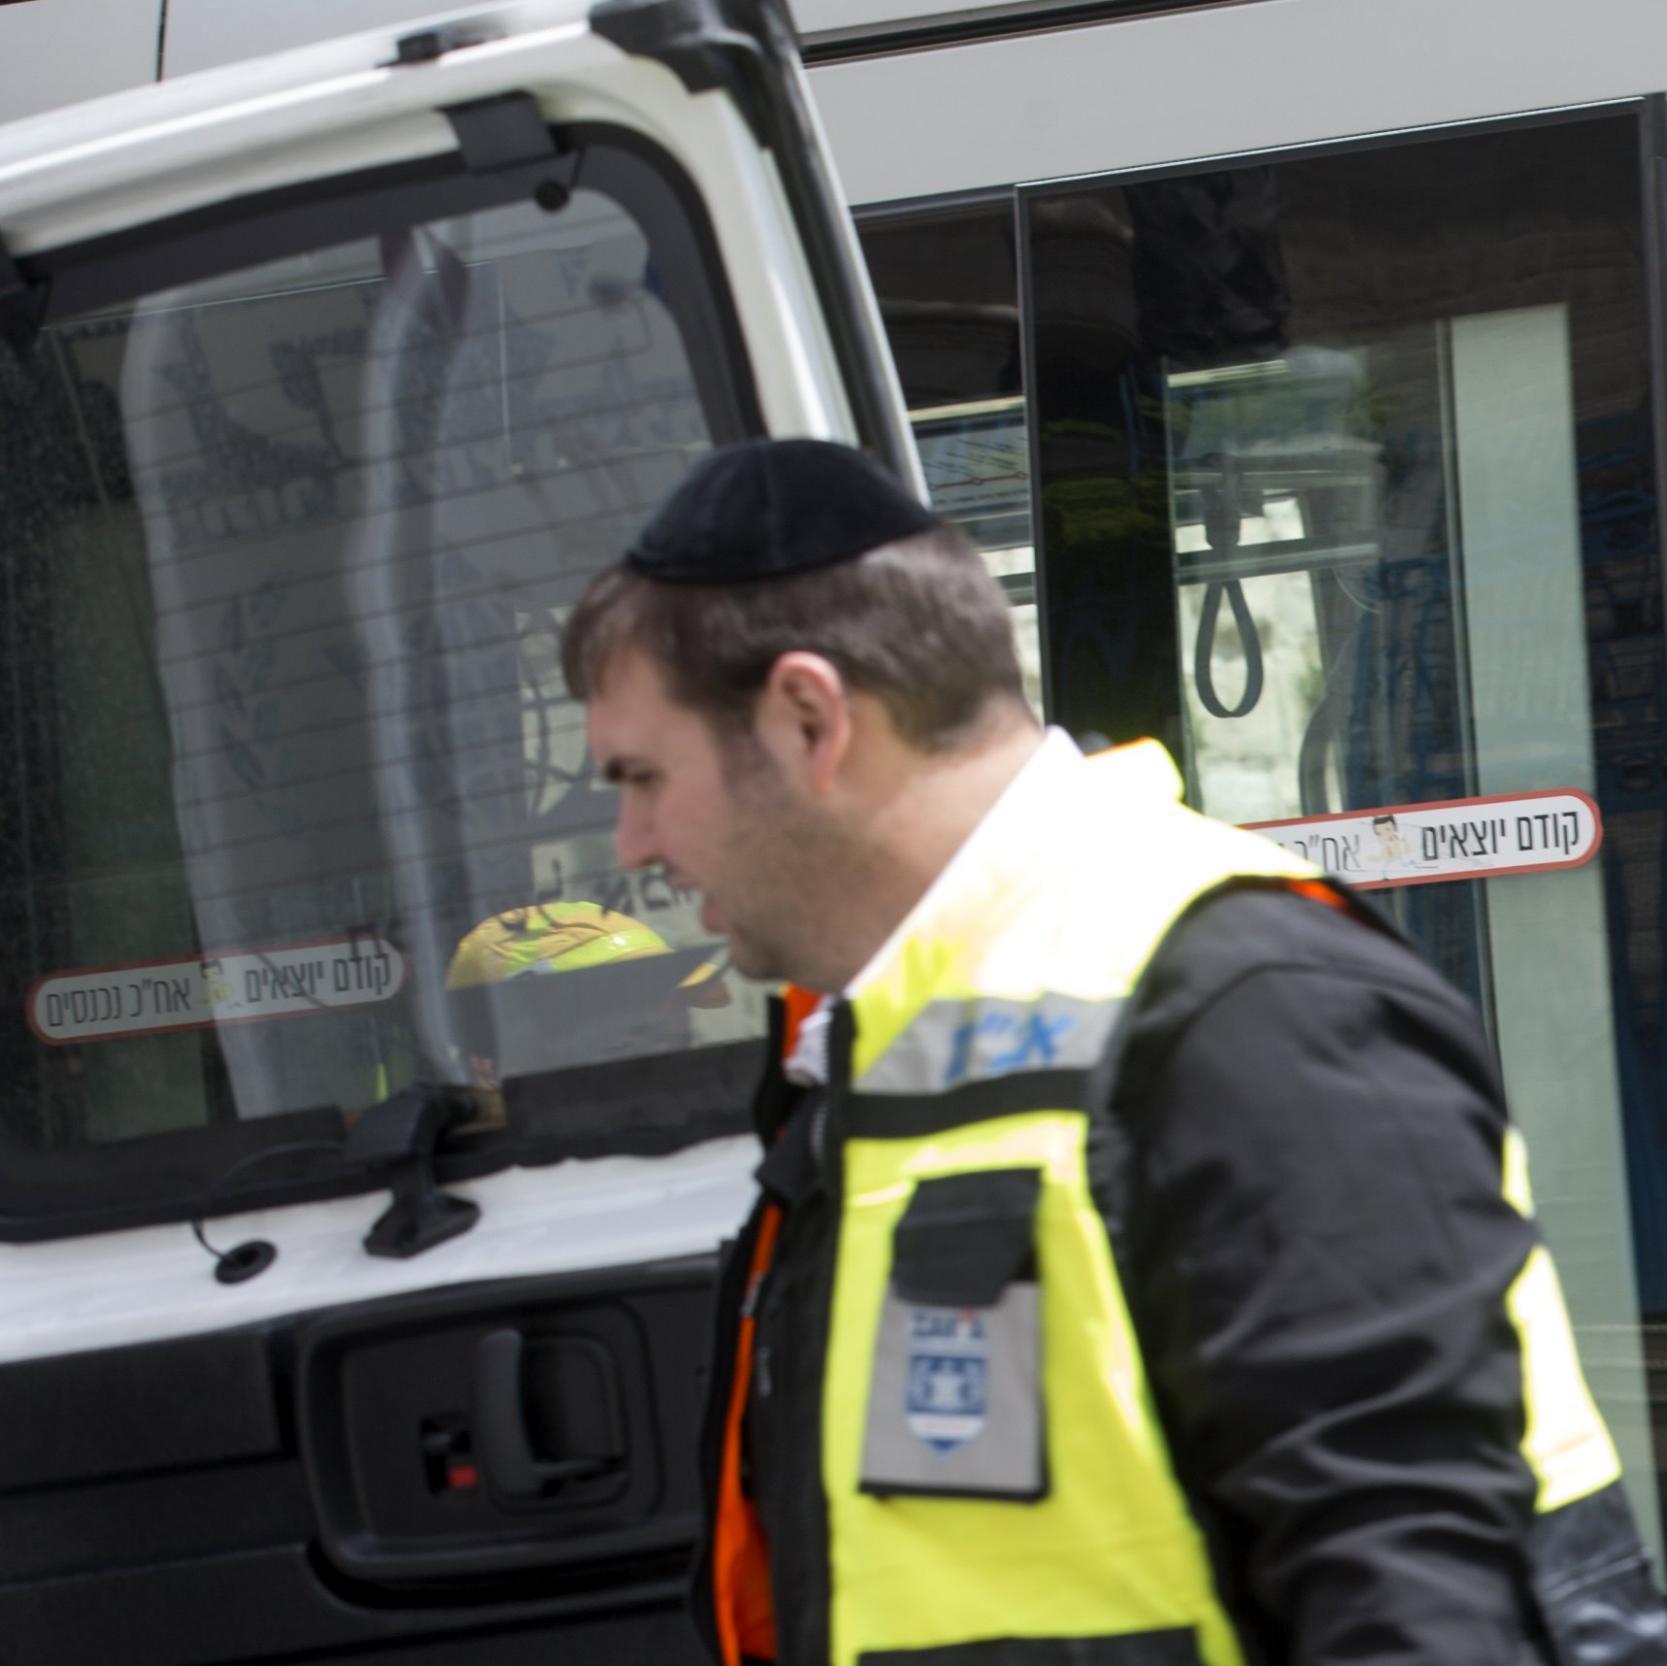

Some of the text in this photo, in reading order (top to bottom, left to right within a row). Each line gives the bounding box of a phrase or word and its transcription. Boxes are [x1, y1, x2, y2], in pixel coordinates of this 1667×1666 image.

[1422, 818, 1506, 861] יוצאים
[1516, 810, 1580, 855] קודם
[244, 960, 325, 1003] יוצאים
[333, 952, 392, 996] קודם
[45, 985, 122, 1027] נכנסים
